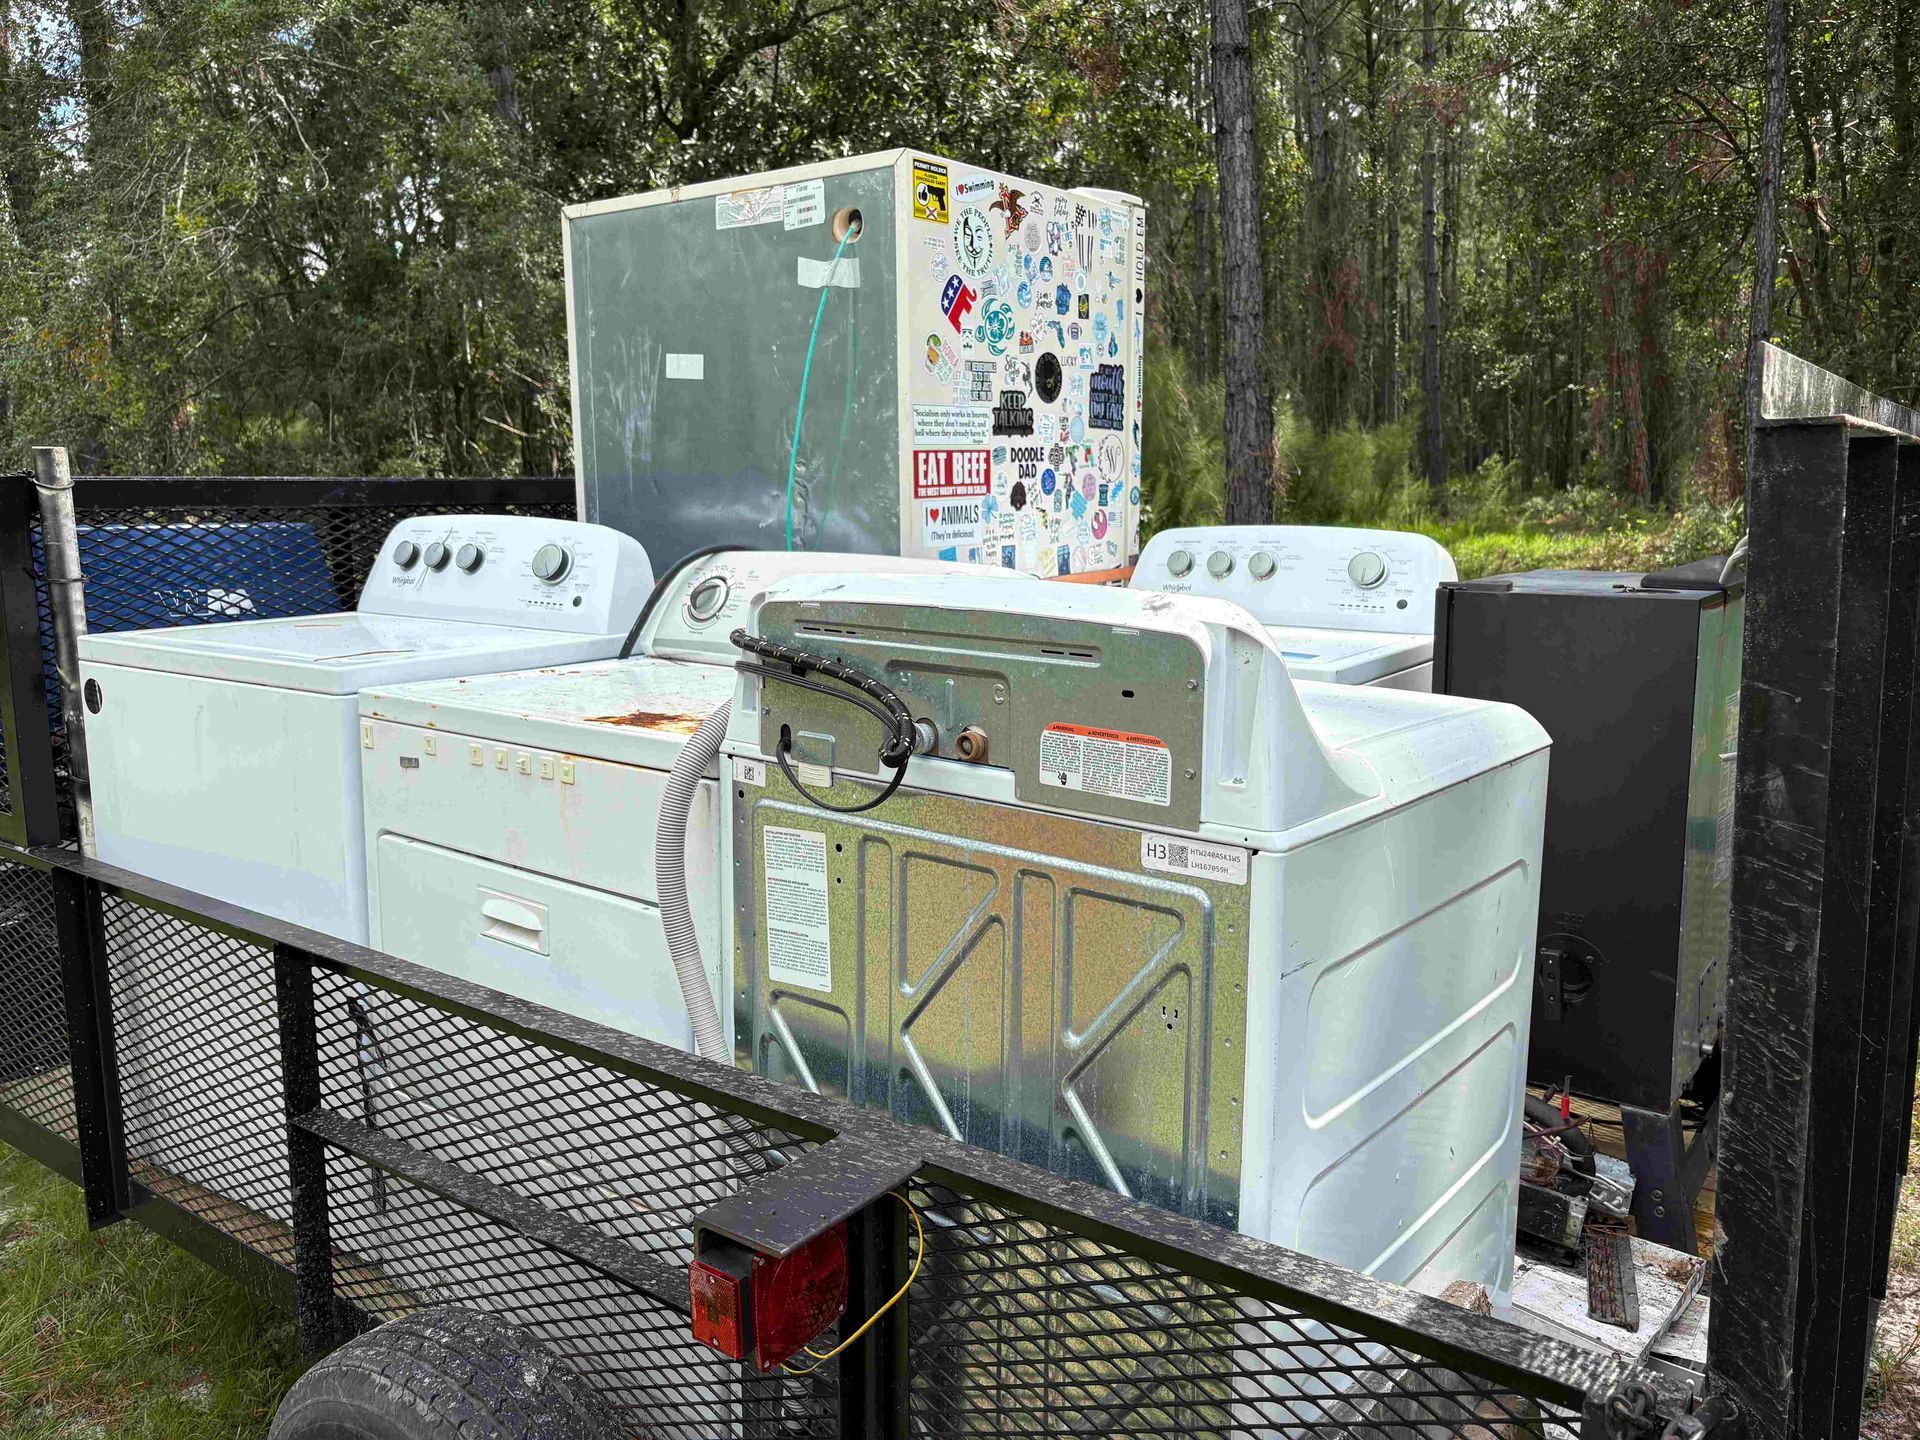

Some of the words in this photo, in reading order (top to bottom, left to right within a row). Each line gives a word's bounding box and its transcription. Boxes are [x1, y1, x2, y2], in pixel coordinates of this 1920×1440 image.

[965, 180, 995, 194] Swimming
[954, 218, 962, 234] WE
[960, 207, 974, 218] THE
[974, 208, 992, 242] PEOPLE
[1136, 216, 1144, 236] EM
[962, 263, 974, 277] THE
[976, 250, 992, 276] TRUTH
[1136, 242, 1144, 281] HOLD
[1000, 394, 1024, 410] KEEP
[918, 419, 933, 428] where
[934, 419, 944, 429] they
[977, 420, 986, 428] and
[993, 410, 1032, 427] TALKING
[925, 429, 940, 437] where
[940, 430, 951, 439] they
[952, 430, 968, 439] already
[1010, 446, 1044, 463] DOODLE
[918, 452, 947, 486] EAT
[952, 452, 987, 484] BEEF
[1018, 464, 1036, 480] DAD
[925, 506, 928, 527] I
[941, 504, 979, 526] ANIMALS
[931, 530, 951, 542] (They're
[392, 575, 415, 586] Whirlpool
[1162, 583, 1192, 593] Whirlpool
[1091, 731, 1119, 739] ADVERTENCIA
[1147, 842, 1166, 860] H3
[1190, 848, 1241, 863] HTW240ASK1WS
[1192, 862, 1229, 875] LH167059H
